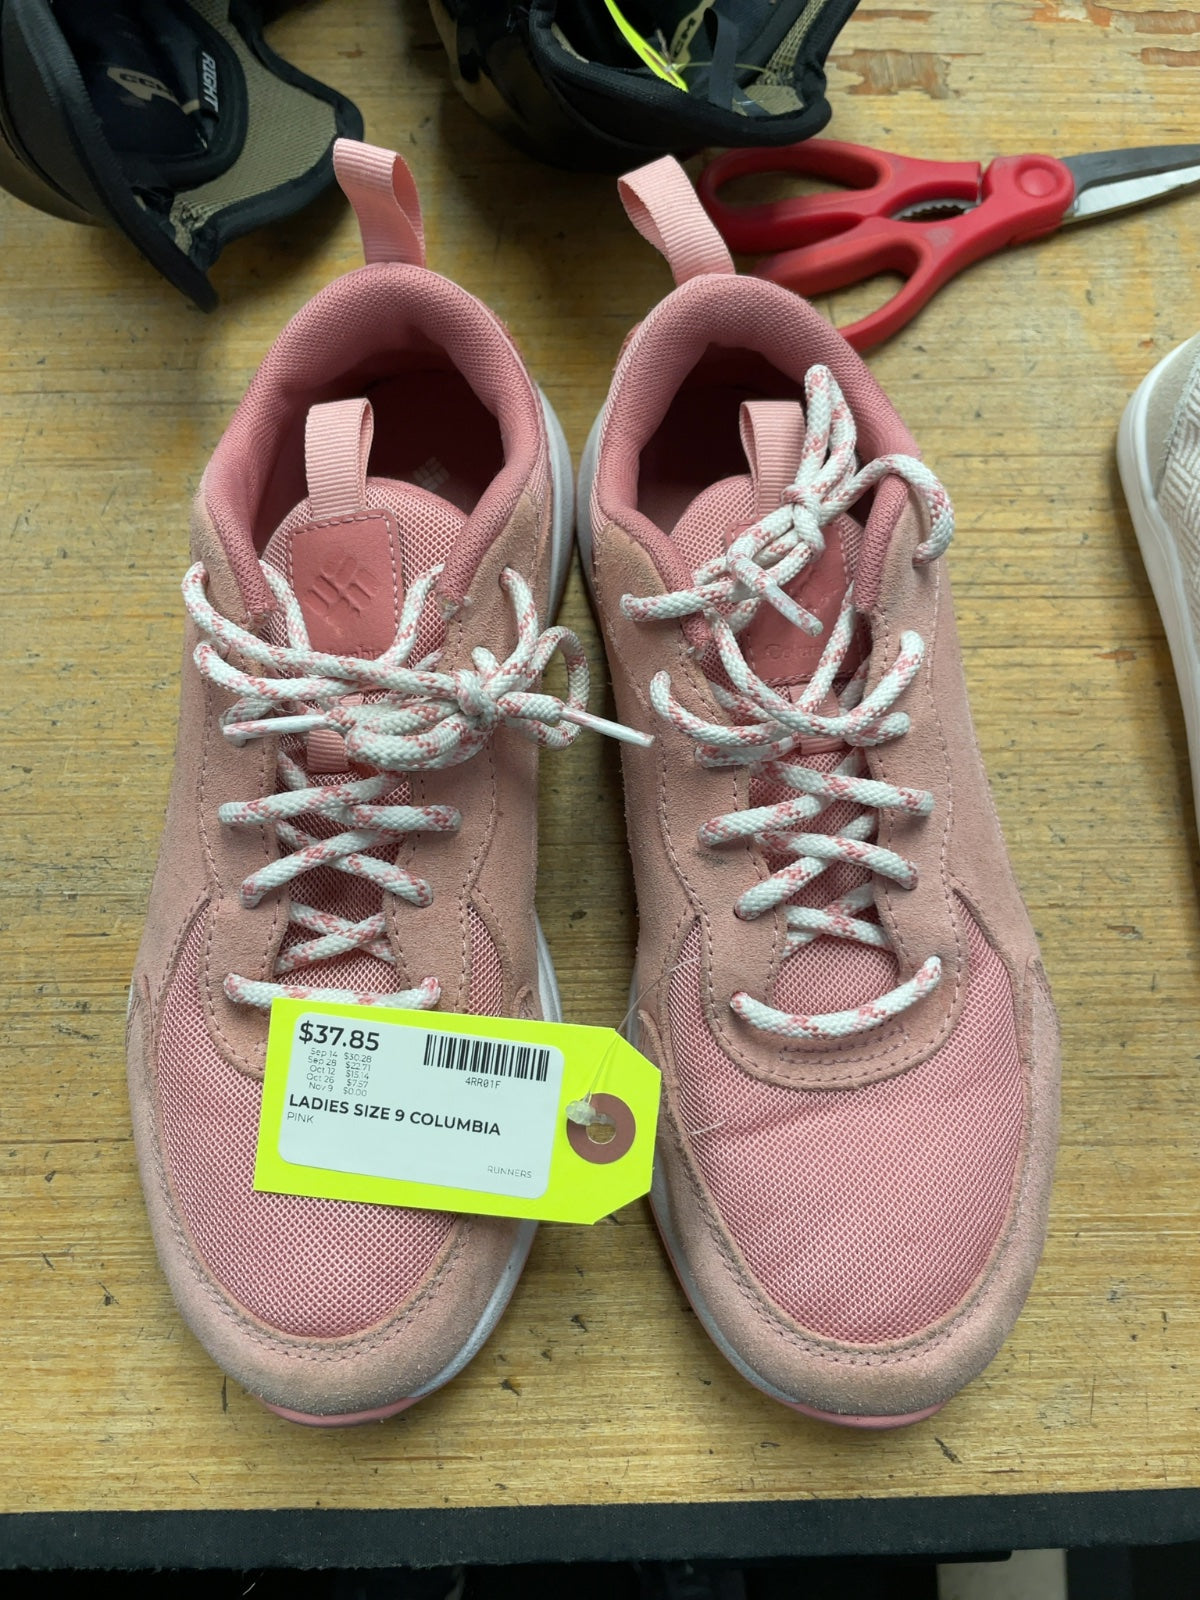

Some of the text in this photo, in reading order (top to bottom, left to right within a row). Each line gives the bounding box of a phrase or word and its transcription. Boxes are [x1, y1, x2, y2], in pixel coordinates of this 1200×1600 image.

[201, 52, 218, 112] RIGHT
[299, 1020, 380, 1051] $37.85
[308, 1056, 324, 1065] Sep
[311, 1047, 327, 1057] Sep
[344, 1052, 372, 1063] $30.28
[306, 1073, 322, 1081] Oct
[310, 1065, 325, 1073] Oct
[328, 1067, 335, 1075] 12
[309, 1082, 325, 1090] Nov
[343, 1087, 367, 1096] $0.00
[287, 1111, 314, 1124] PINK
[289, 1094, 501, 1135] LADIES SIZE 9 COLUMBIA
[488, 1165, 532, 1179] RUNNERS
